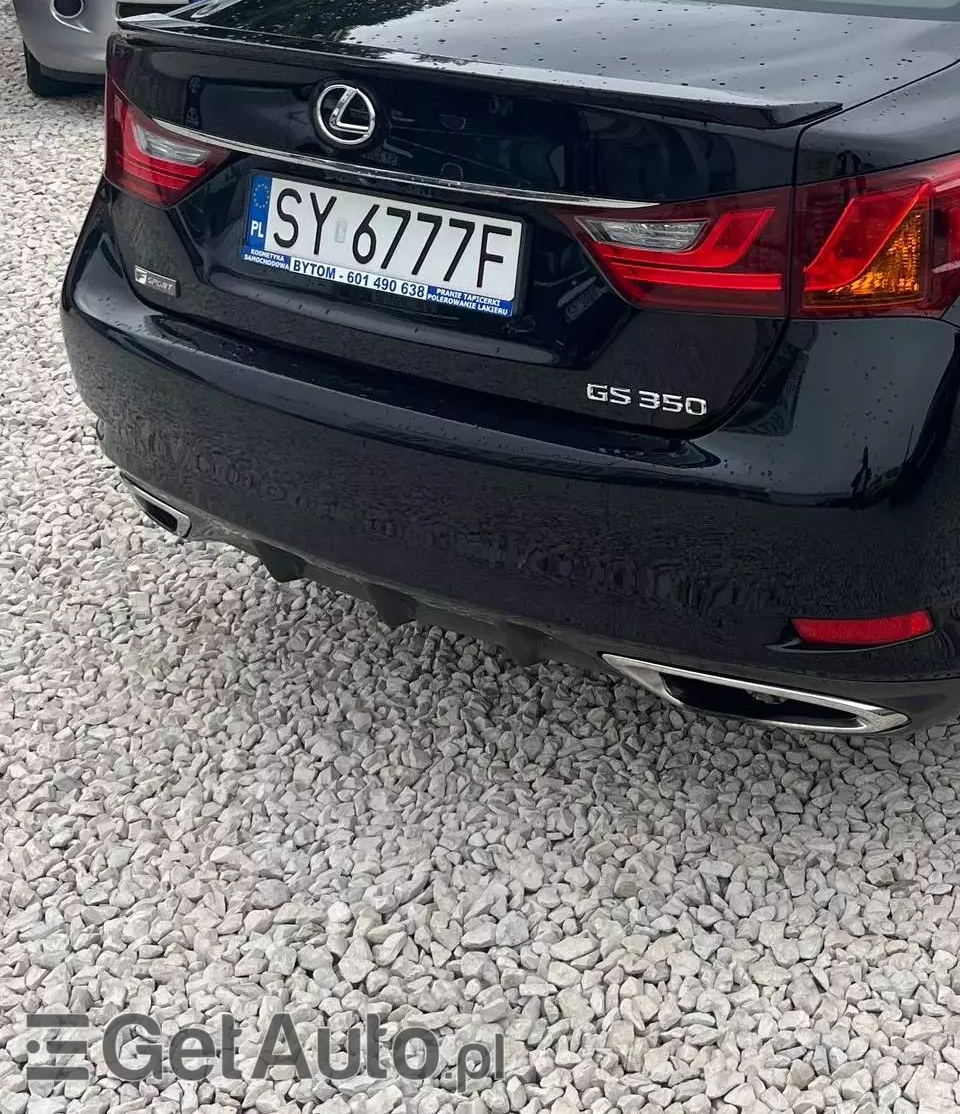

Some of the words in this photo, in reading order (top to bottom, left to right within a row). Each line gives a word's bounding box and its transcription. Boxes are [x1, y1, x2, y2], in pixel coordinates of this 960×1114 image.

[250, 219, 264, 239] PL
[273, 187, 338, 256] SY
[352, 203, 513, 288] 6777F
[243, 253, 290, 270] SAMOCHODOWA
[250, 248, 285, 262] KOSMETYKA
[147, 276, 173, 291] SPORT
[293, 259, 336, 280] BYTOM
[347, 271, 369, 287] 601
[373, 276, 397, 292] 490
[400, 281, 425, 298] 638
[427, 293, 476, 310] POLEROWANIE
[478, 303, 508, 316] LAKIERU
[436, 288, 462, 299] PRANIE
[463, 293, 501, 307] TAPICERKI
[586, 383, 632, 405] GS
[638, 390, 707, 416] 350
